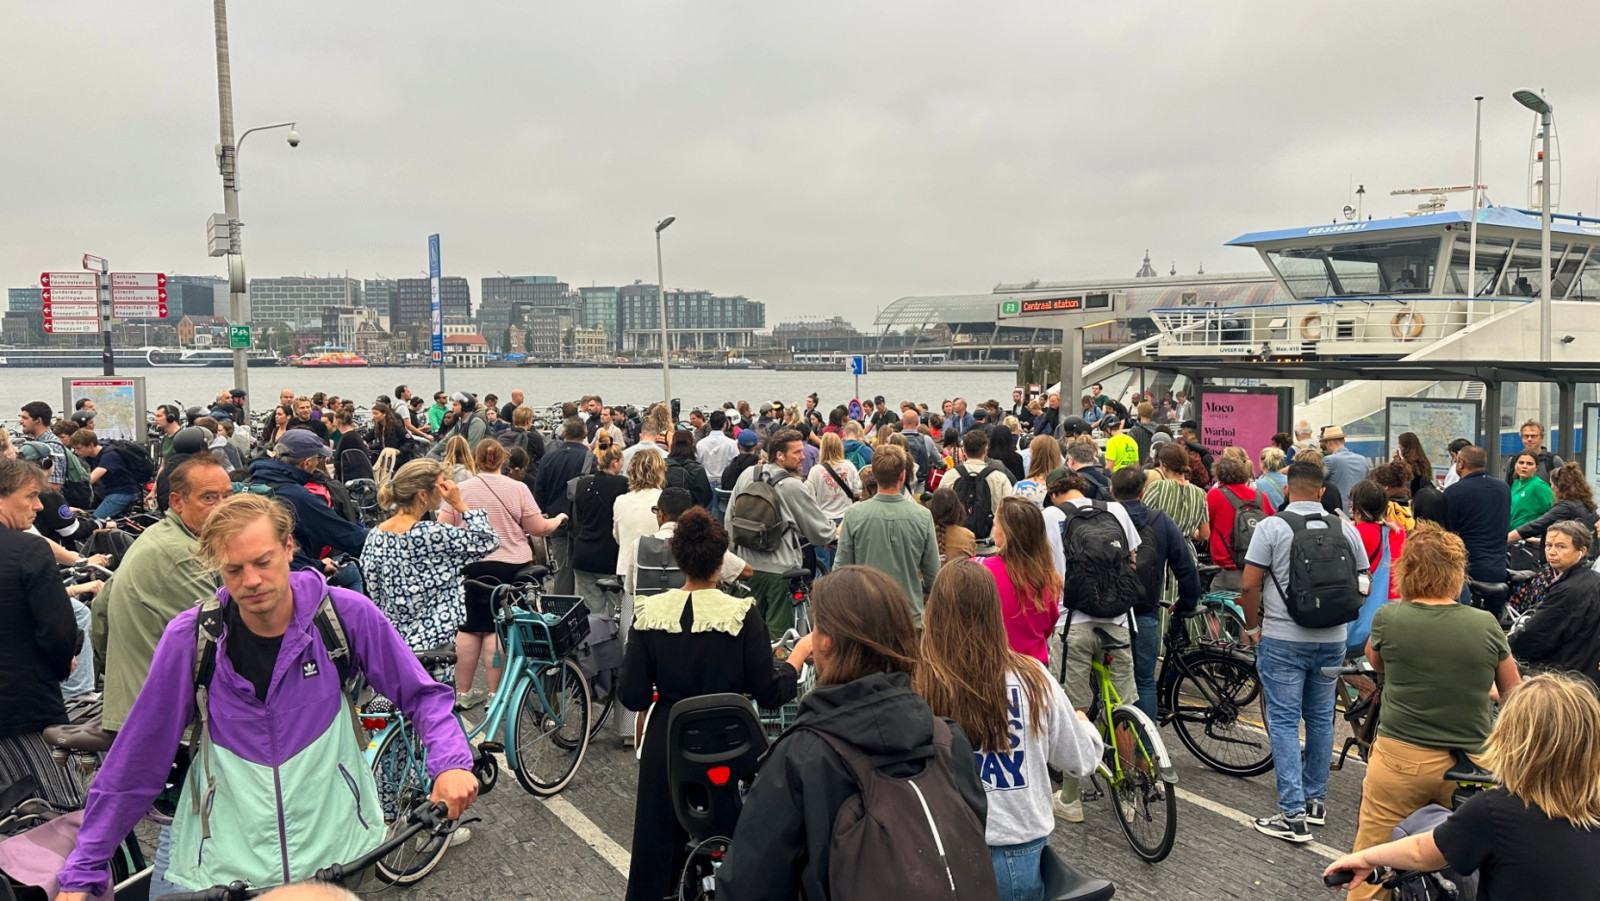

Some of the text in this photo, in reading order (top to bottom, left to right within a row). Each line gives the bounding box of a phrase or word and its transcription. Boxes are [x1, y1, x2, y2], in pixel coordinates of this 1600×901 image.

[1007, 303, 1015, 312] F3
[1023, 299, 1079, 311] Centraal station
[231, 327, 238, 336] P
[1205, 402, 1234, 413] Moco
[1204, 427, 1236, 437] Warhol
[1204, 438, 1233, 447] Haring
